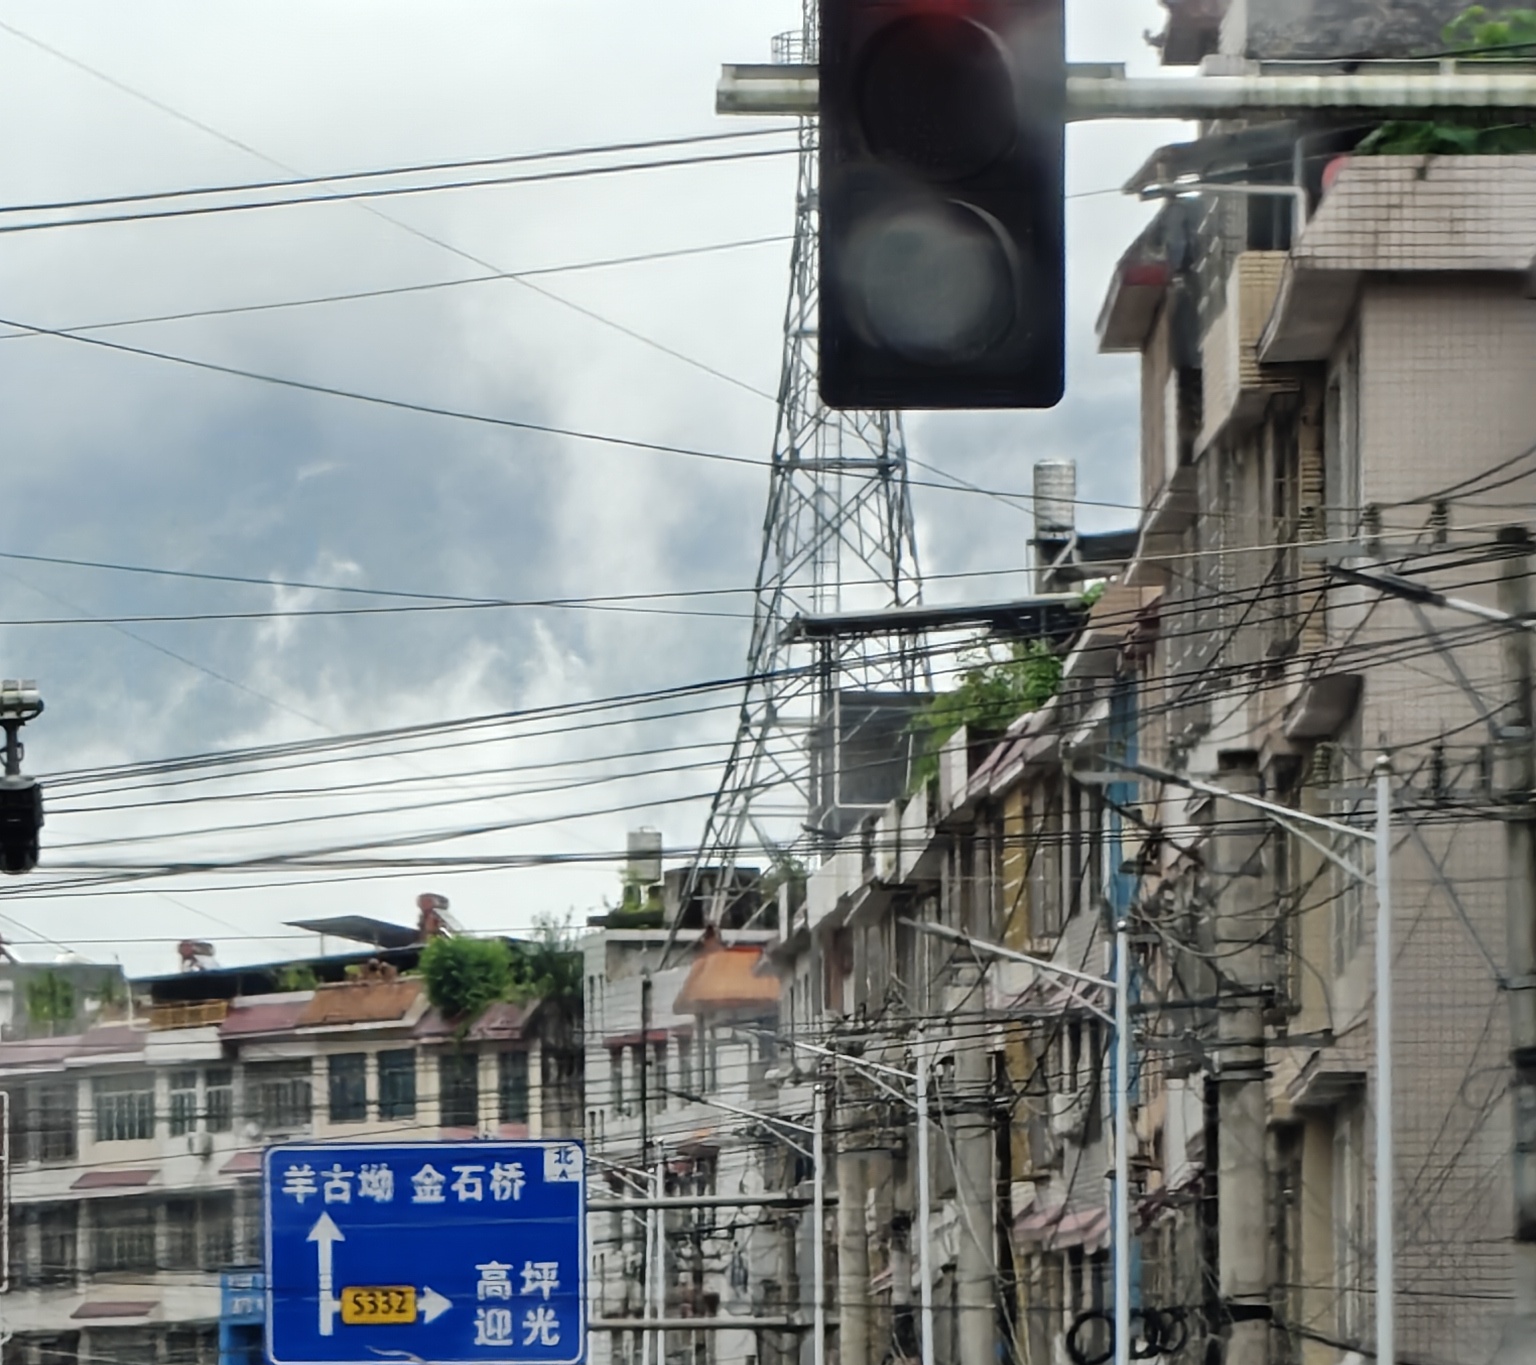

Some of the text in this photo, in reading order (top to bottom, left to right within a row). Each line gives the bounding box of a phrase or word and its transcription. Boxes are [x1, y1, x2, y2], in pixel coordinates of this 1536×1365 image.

[553, 1146, 574, 1166] 北
[282, 1162, 527, 1204] 羊古坳 金石桥
[474, 1260, 561, 1301] 高坪
[352, 1291, 408, 1316] S332
[473, 1308, 561, 1347] 迎光
